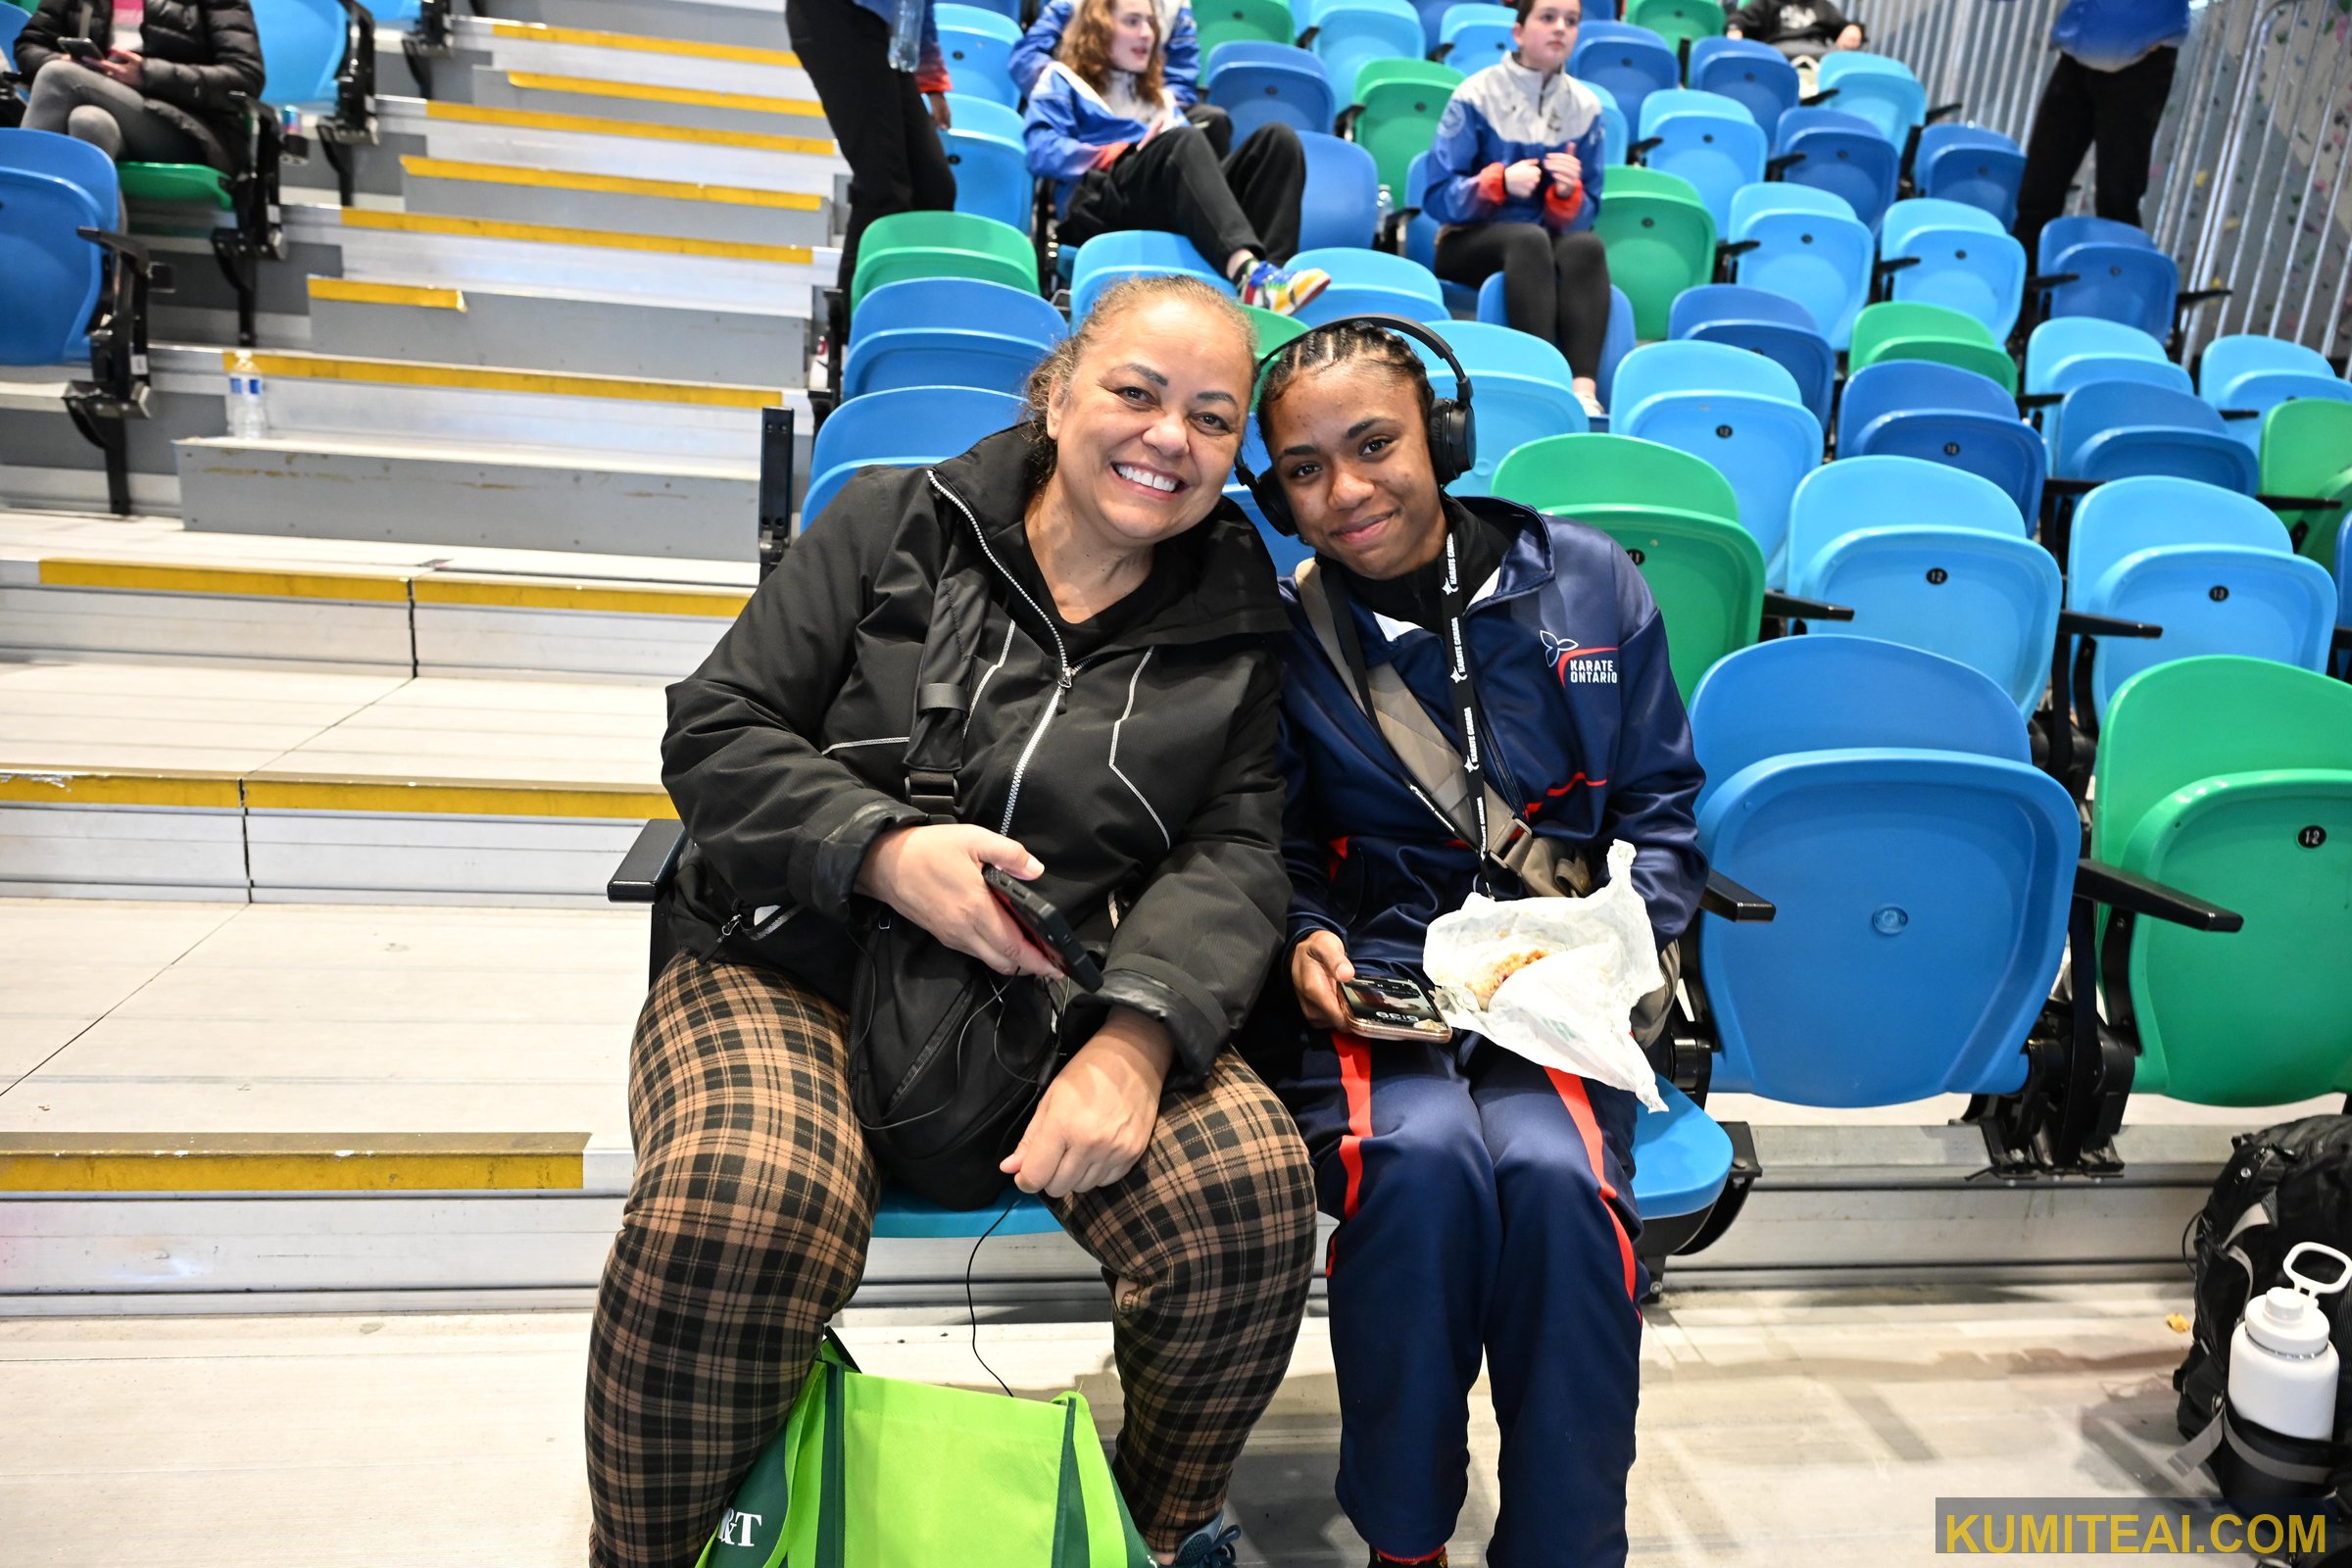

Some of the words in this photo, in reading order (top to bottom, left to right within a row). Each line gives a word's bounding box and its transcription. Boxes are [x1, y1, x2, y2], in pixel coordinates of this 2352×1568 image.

[1448, 558, 1457, 585] KARATE
[1932, 570, 1943, 582] 12
[1450, 616, 1461, 646] CANADA
[1454, 645, 1466, 673] KARATE
[1570, 660, 1614, 672] KARATE
[1570, 670, 1618, 684] ONTARIO
[1463, 707, 1475, 736] CANADA
[1468, 735, 1479, 763] KARATE
[2305, 829, 2320, 845] 12
